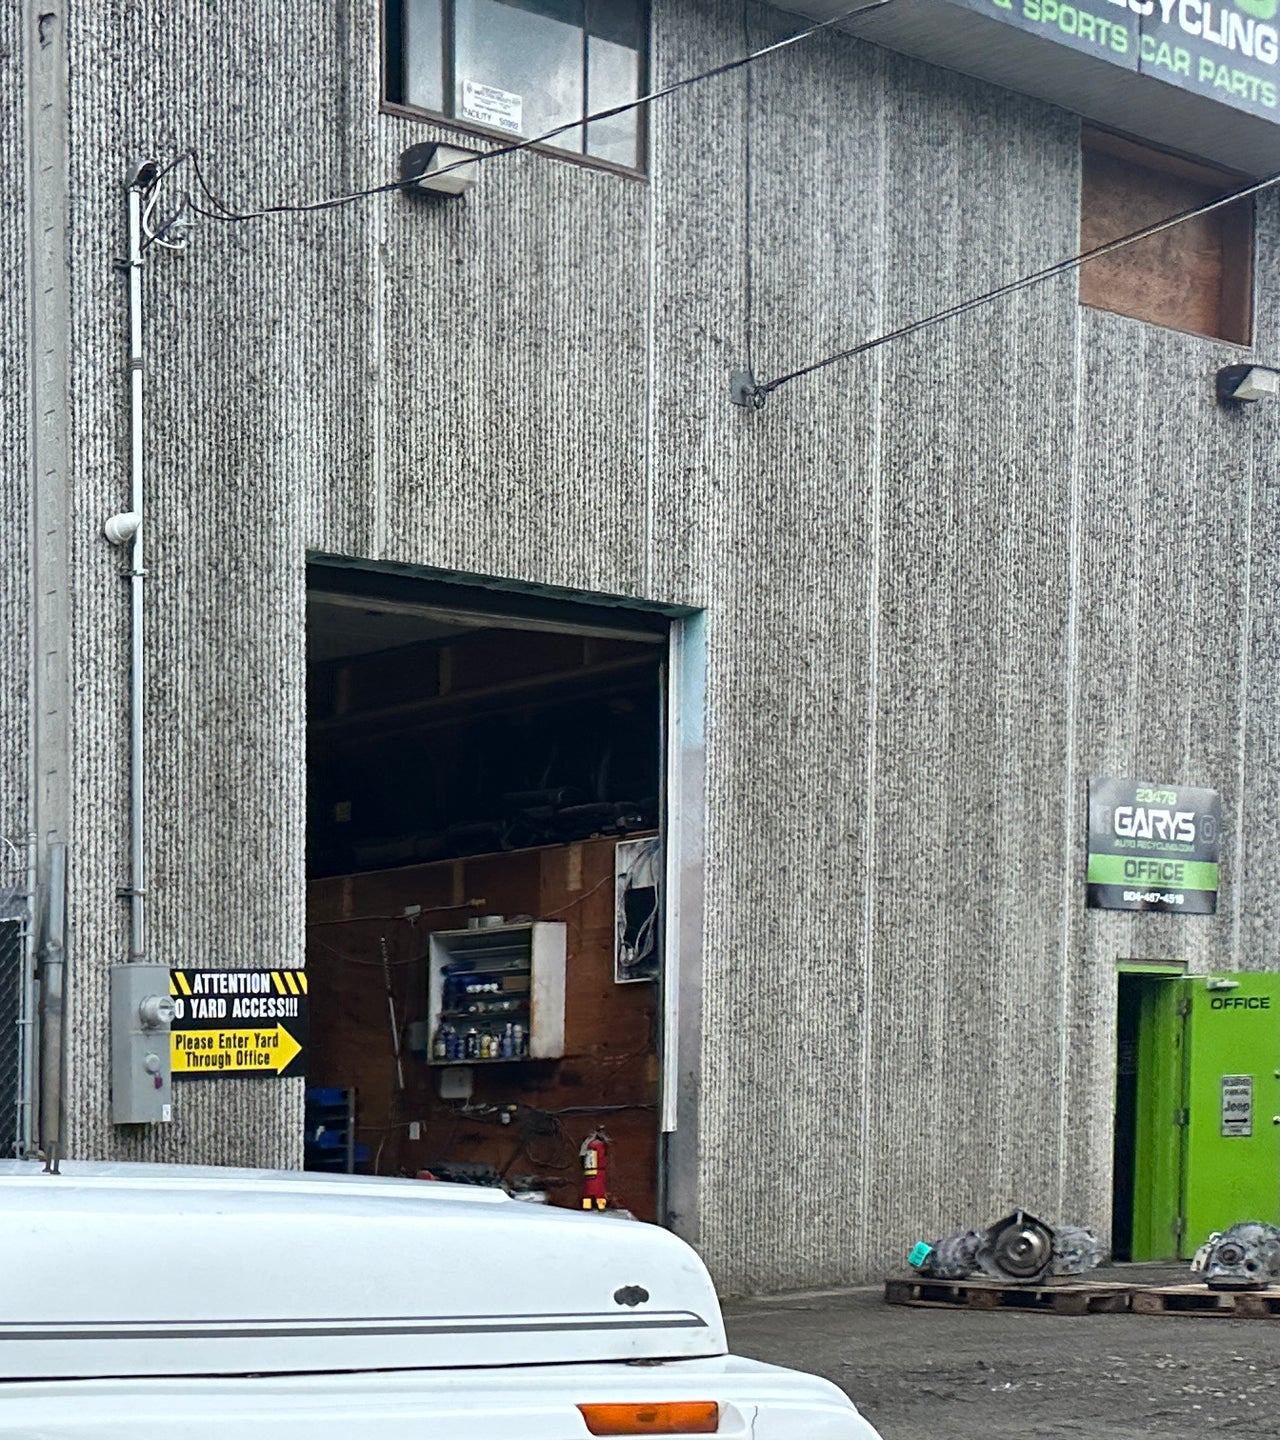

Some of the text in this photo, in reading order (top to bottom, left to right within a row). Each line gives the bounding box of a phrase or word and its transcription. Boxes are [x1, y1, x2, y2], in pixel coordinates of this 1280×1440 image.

[1106, 0, 1278, 65] YCLING
[1023, 0, 1277, 108] SPORTS CAR PARTS
[1114, 806, 1196, 842] GARYS
[1124, 859, 1184, 881] OFFICE
[193, 973, 271, 994] ATTENTION
[175, 997, 298, 1019] O YARD ACCESS!!!
[1211, 997, 1270, 1010] OFFICE
[176, 1032, 279, 1051] Please Enter Yard
[185, 1050, 270, 1069] Through Office
